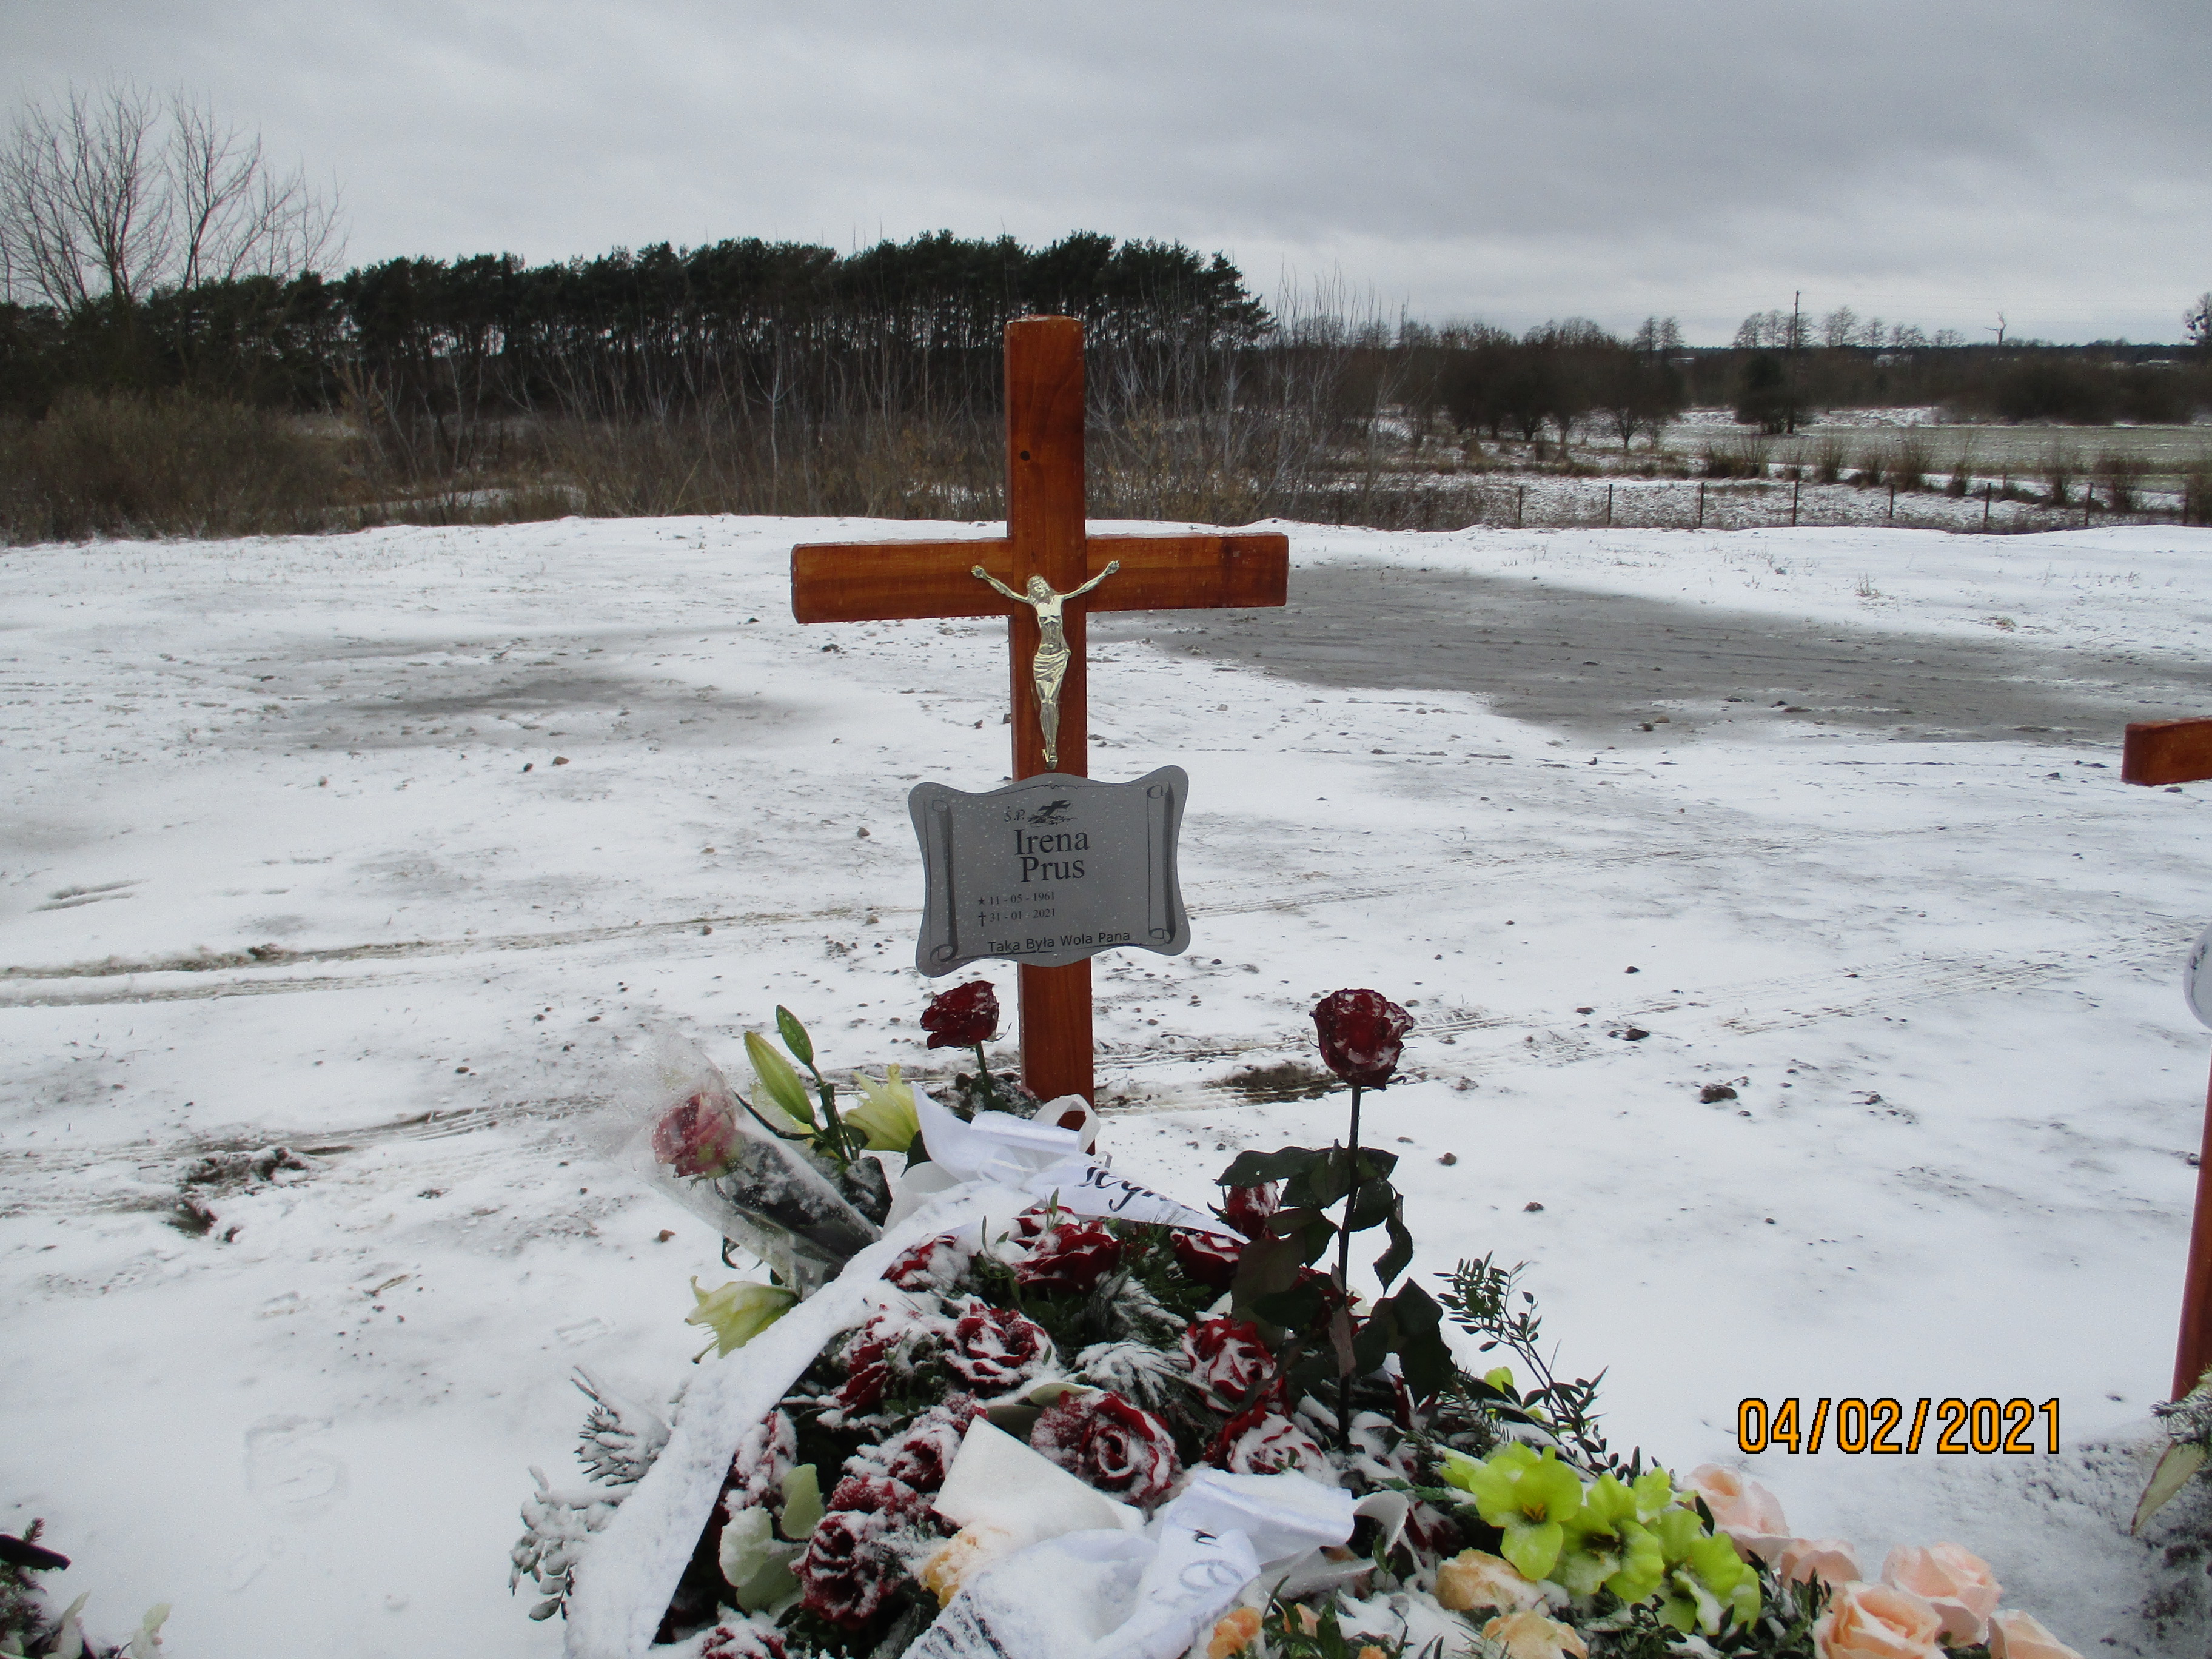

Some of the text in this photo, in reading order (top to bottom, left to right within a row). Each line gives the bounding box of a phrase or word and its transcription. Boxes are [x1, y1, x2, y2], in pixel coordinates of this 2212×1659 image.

[1014, 828, 1090, 856] Irena
[1021, 857, 1085, 883] Prus
[990, 896, 1000, 905] 11
[1010, 894, 1022, 903] 05
[1033, 891, 1055, 902] 1961
[990, 913, 1000, 922] 31
[1011, 911, 1022, 920] 01
[1033, 908, 1056, 919] 2021
[988, 931, 1130, 953] Taka Była Wola Pana
